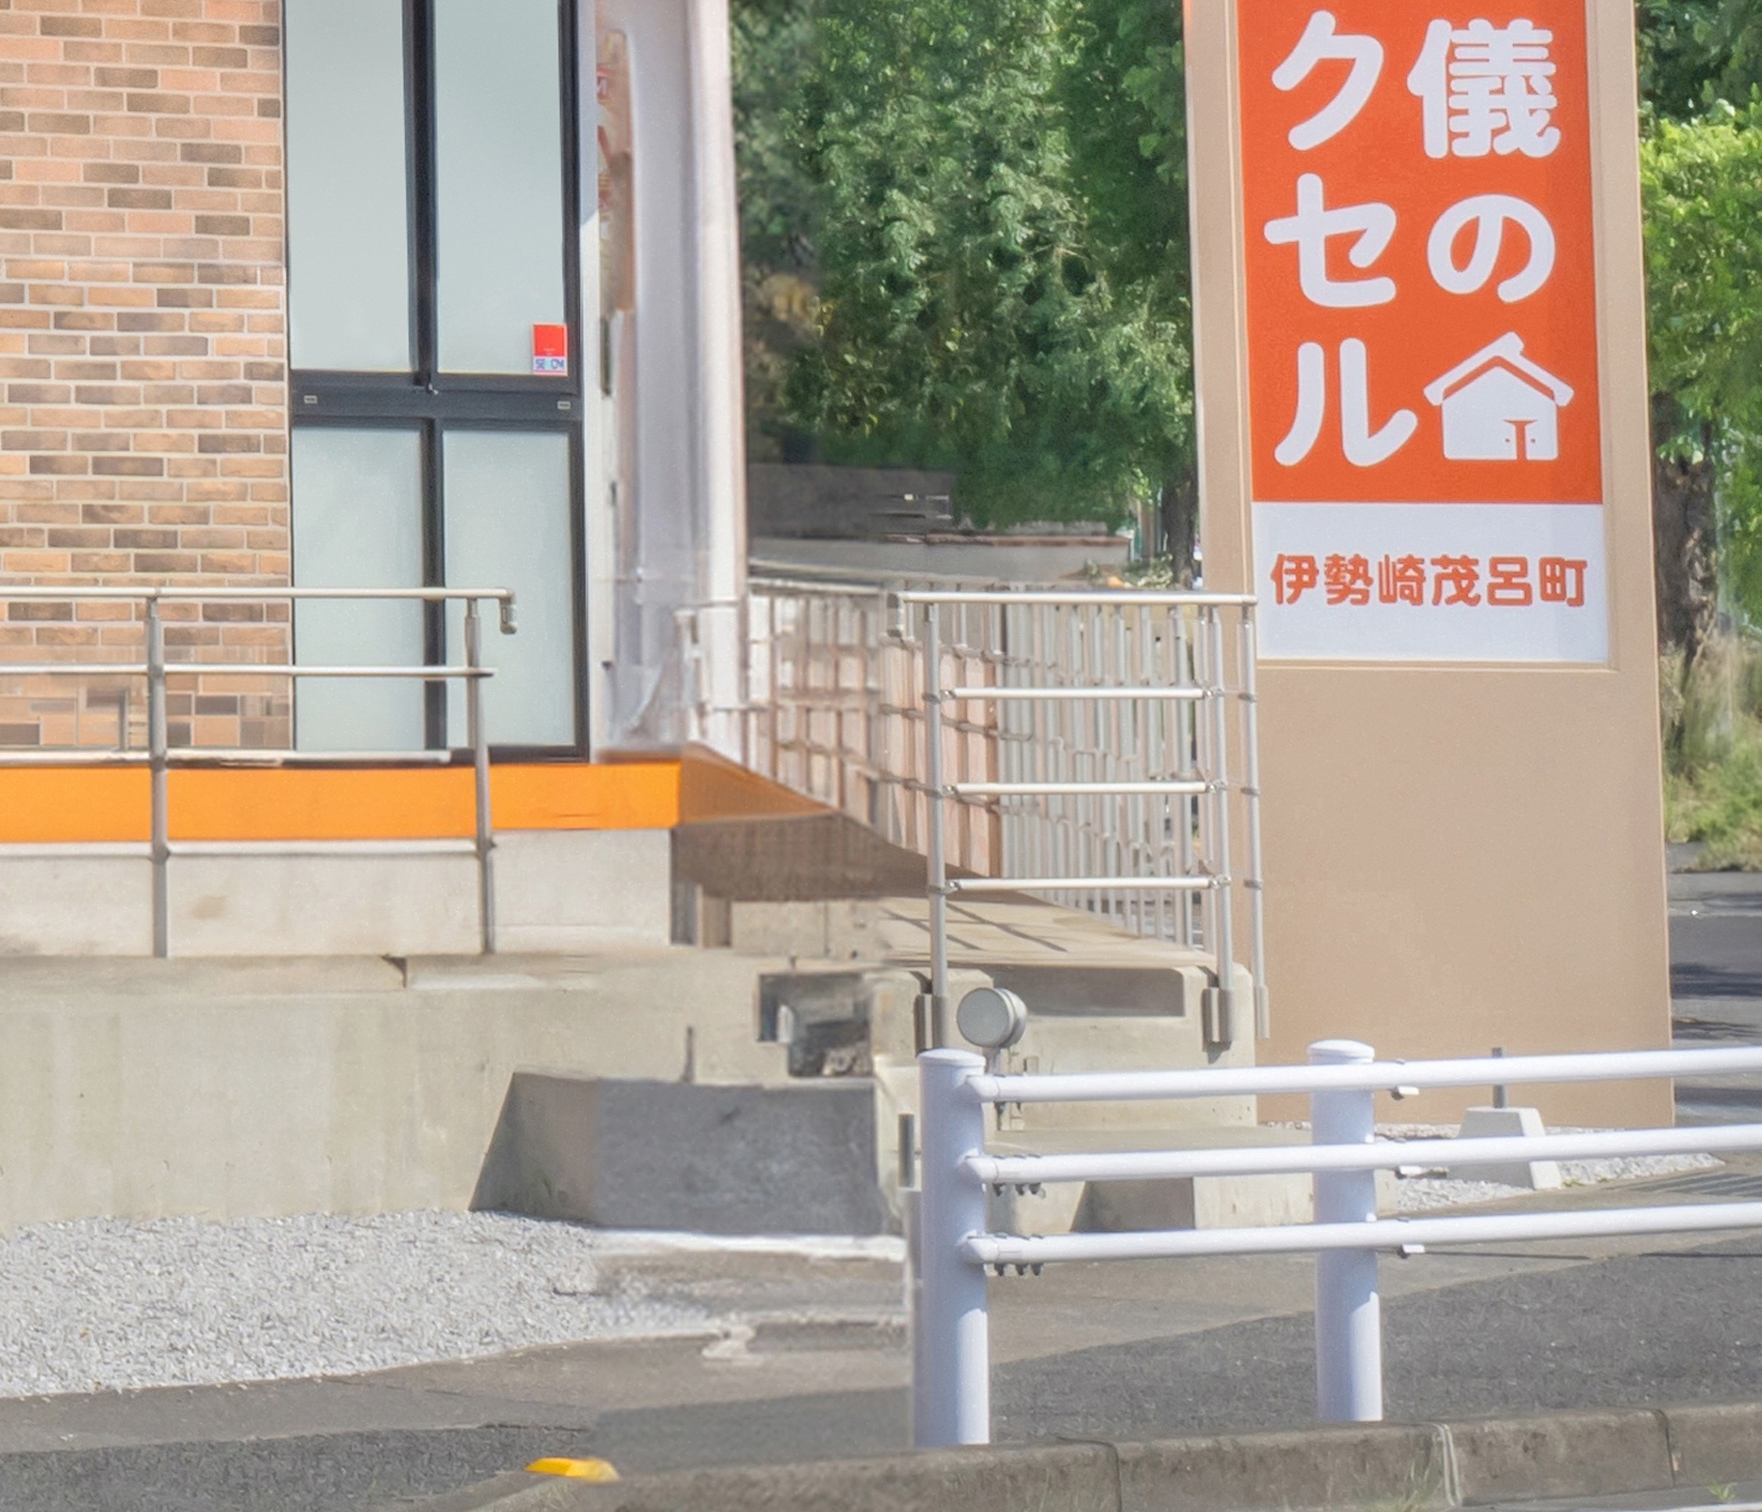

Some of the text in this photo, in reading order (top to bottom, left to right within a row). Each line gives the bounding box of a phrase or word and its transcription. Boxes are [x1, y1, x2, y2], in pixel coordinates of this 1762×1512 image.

[1270, 553, 1588, 607] 伊勢崎茂呂町
